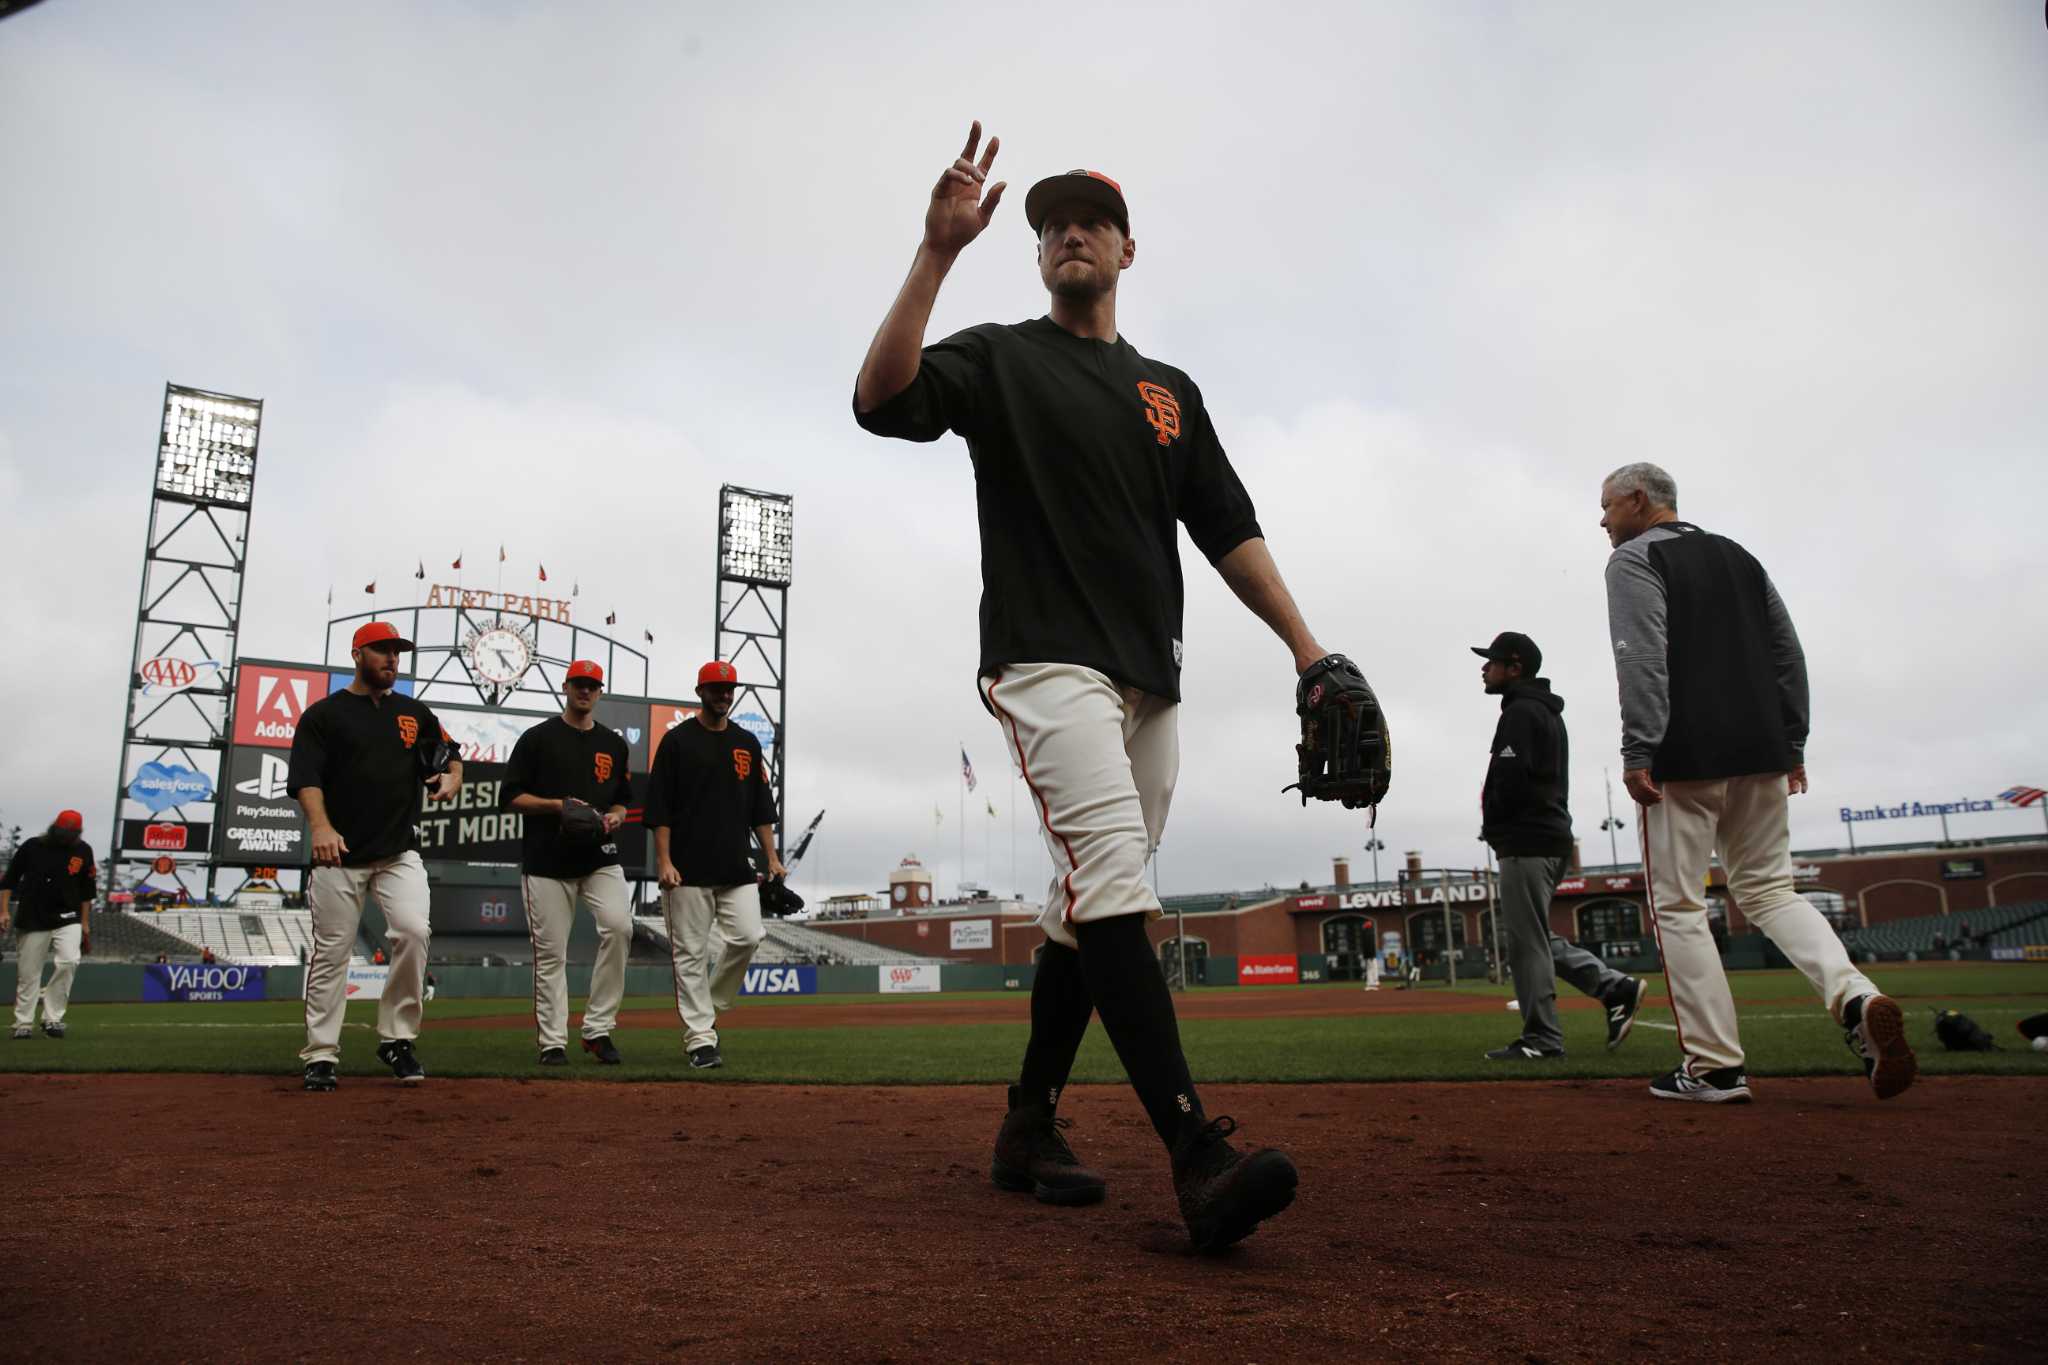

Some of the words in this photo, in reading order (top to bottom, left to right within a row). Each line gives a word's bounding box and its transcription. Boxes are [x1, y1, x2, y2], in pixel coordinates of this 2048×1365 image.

[426, 584, 492, 608] AT&T
[504, 592, 571, 625] PARK
[150, 658, 191, 687] AAA
[255, 721, 296, 738] Adob
[140, 777, 205, 792] salesforce
[1840, 804, 1886, 822] Bank
[1889, 803, 1908, 818] of
[1911, 797, 1994, 817] America
[227, 827, 302, 843] GREATNESS
[167, 966, 248, 991] YAHOO!
[743, 969, 800, 992] VISA
[189, 991, 222, 1000] SPORTS
